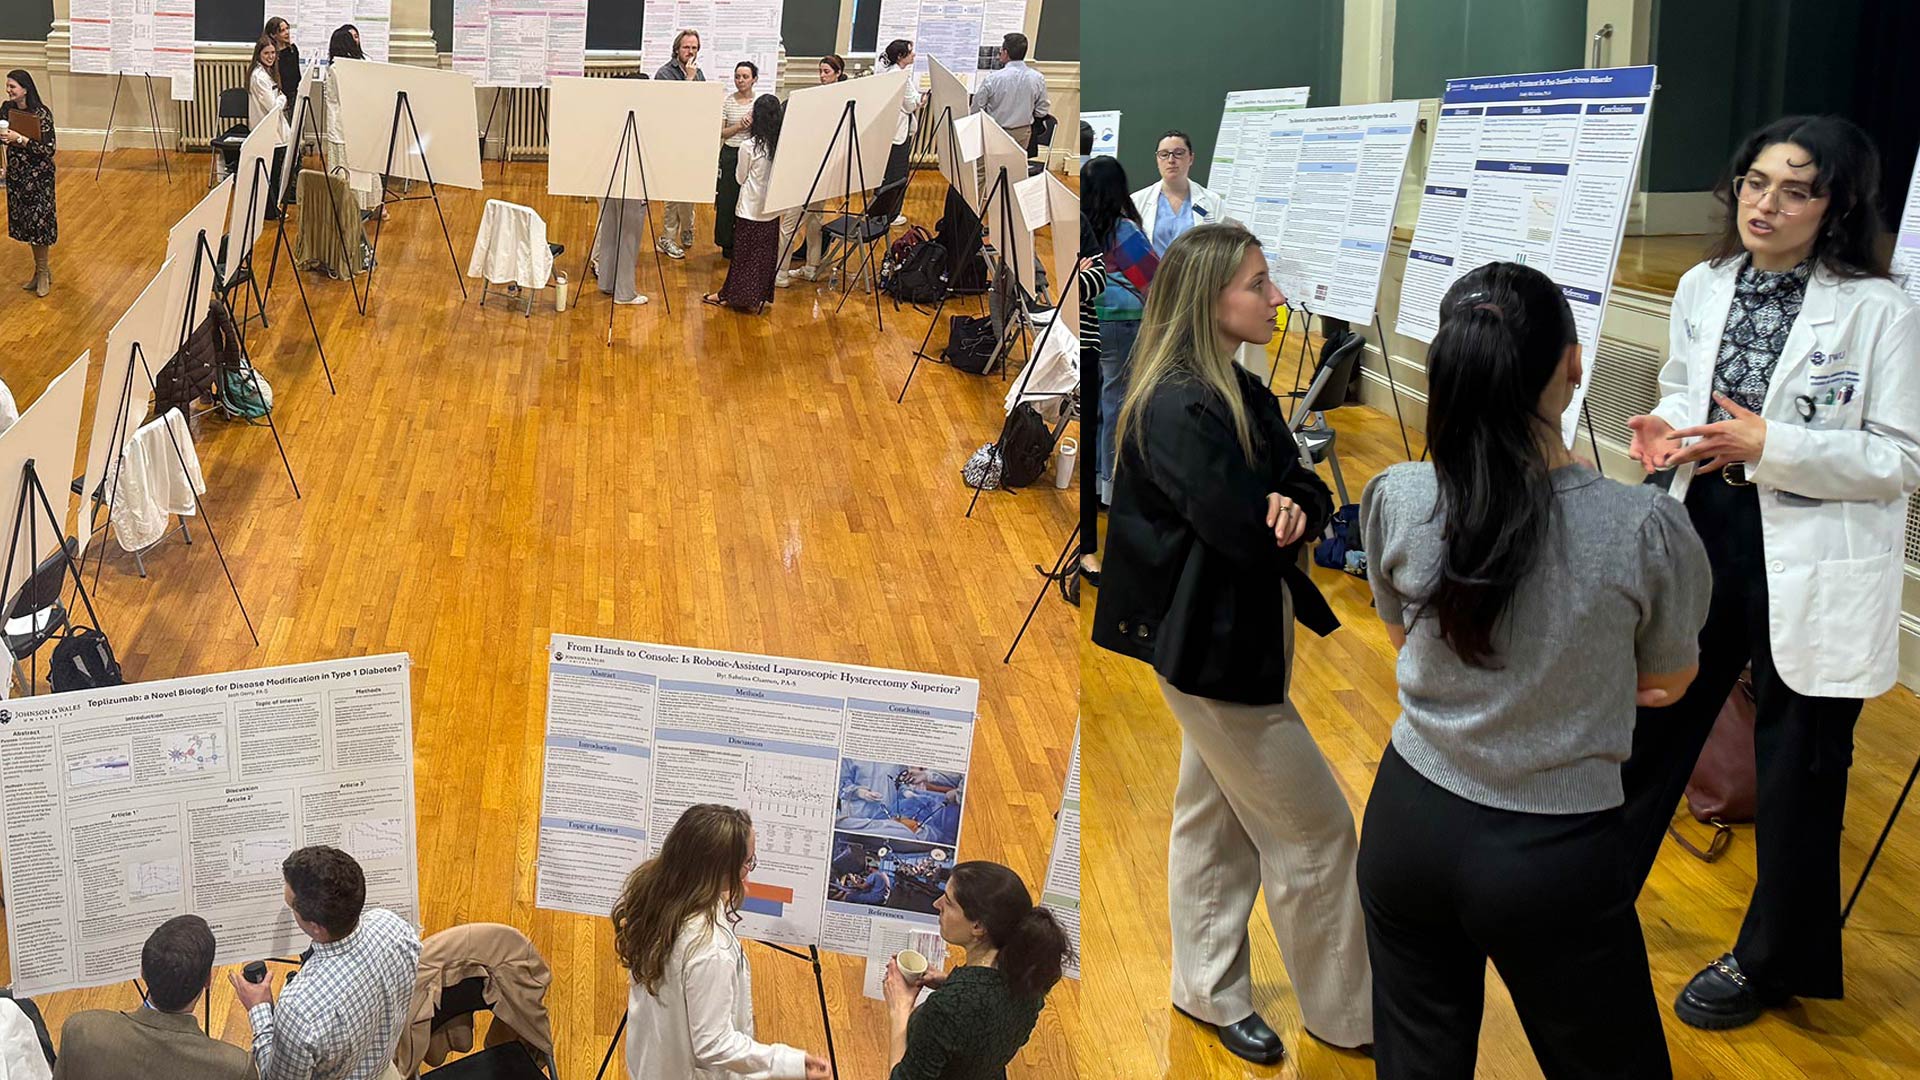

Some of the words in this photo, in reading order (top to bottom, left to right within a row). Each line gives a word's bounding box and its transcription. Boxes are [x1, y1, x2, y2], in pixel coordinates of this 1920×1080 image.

[1590, 75, 1614, 83] Disorder
[1599, 104, 1633, 113] Conclusions
[567, 641, 592, 653] From
[594, 644, 625, 657] Hands
[626, 649, 636, 658] to
[638, 650, 679, 664] Console:
[682, 655, 691, 665] Is
[693, 656, 770, 673] Robotic-Assisted
[773, 663, 838, 681] Laparoscopic
[840, 672, 907, 690] Hysterectomy
[910, 680, 961, 695] Superior?
[590, 669, 616, 679] Abstract
[88, 694, 142, 708] Teplizumab:
[143, 693, 150, 701] a
[151, 689, 177, 701] Novel
[178, 684, 214, 698] Biologic
[215, 682, 228, 693] for
[229, 680, 264, 691] Disease
[266, 674, 320, 687] Modification
[321, 672, 330, 681] in
[331, 670, 351, 681] Type
[353, 669, 358, 677] 1
[359, 664, 402, 676] Diabetes?
[355, 687, 381, 695] Methods
[735, 687, 765, 699] Methods
[255, 699, 271, 707] Topic
[279, 697, 303, 705] Interest
[15, 709, 51, 719] JOHNSON
[58, 704, 81, 713] WALES
[888, 703, 931, 716] Conclusions
[125, 712, 164, 722] Introduction
[13, 729, 41, 737] Abstract
[578, 740, 618, 752] Introduction
[728, 736, 764, 748] Discussion
[225, 784, 259, 795] Discussion
[340, 782, 359, 790] Article
[227, 796, 246, 804] Article
[111, 811, 131, 819] Article
[568, 821, 586, 830] Topic
[867, 907, 905, 920] References
